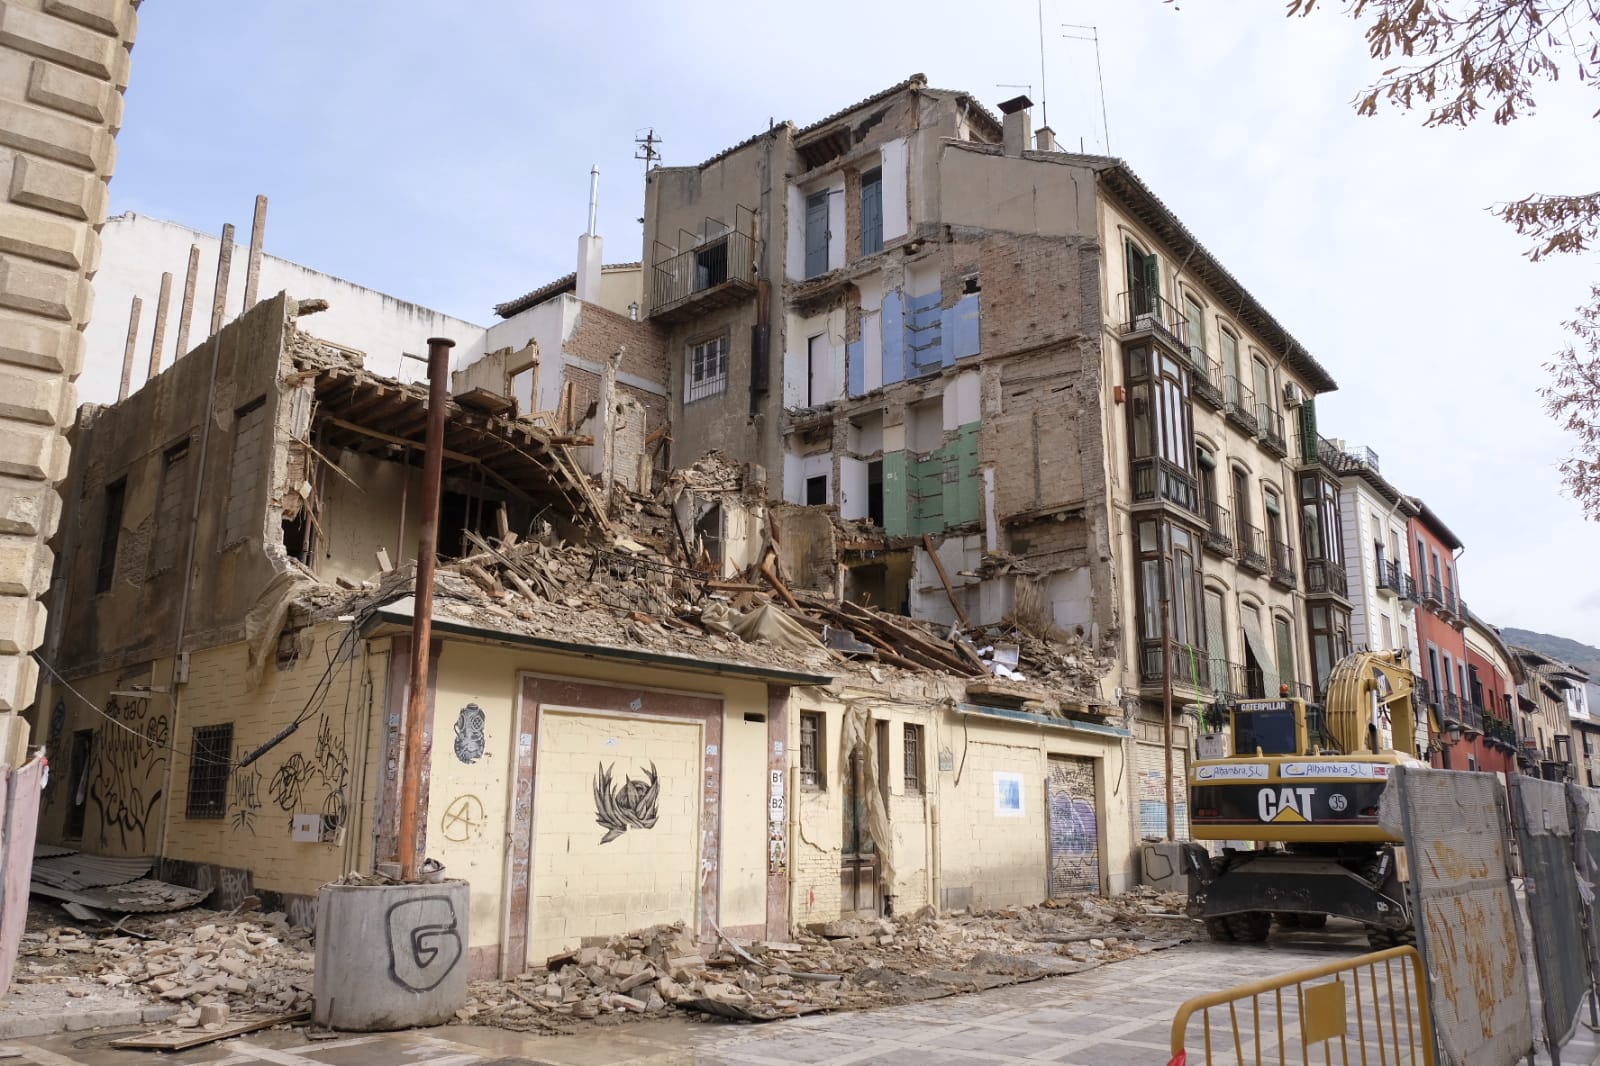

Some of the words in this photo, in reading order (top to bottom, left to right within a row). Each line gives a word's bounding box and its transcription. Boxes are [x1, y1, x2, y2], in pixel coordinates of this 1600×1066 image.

[1241, 701, 1286, 712] CATERPILLAR
[772, 772, 783, 783] B1
[772, 798, 783, 809] B2
[1258, 787, 1315, 823] CAT
[1333, 795, 1346, 809] 35
